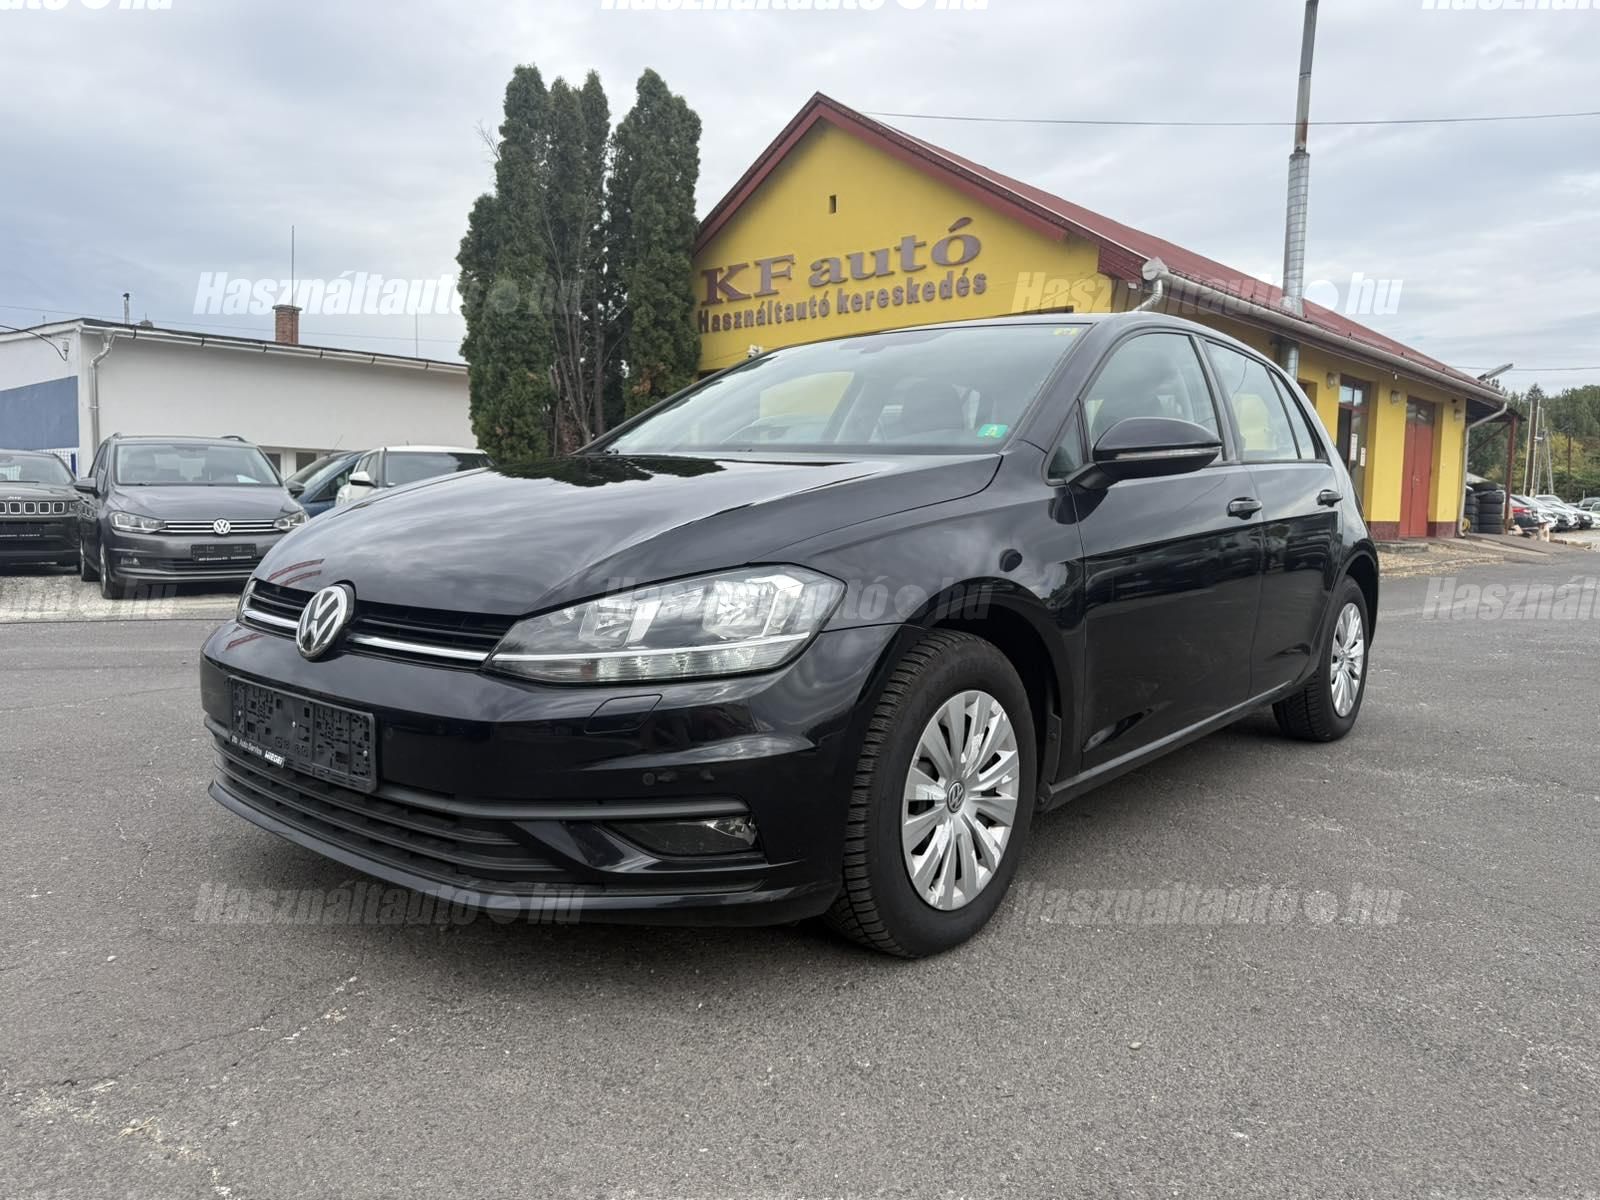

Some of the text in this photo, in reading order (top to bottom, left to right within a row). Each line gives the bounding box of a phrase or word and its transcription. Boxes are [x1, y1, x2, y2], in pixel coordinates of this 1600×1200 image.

[702, 216, 982, 305] KF autó
[698, 268, 988, 334] Használtautó kereskedés
